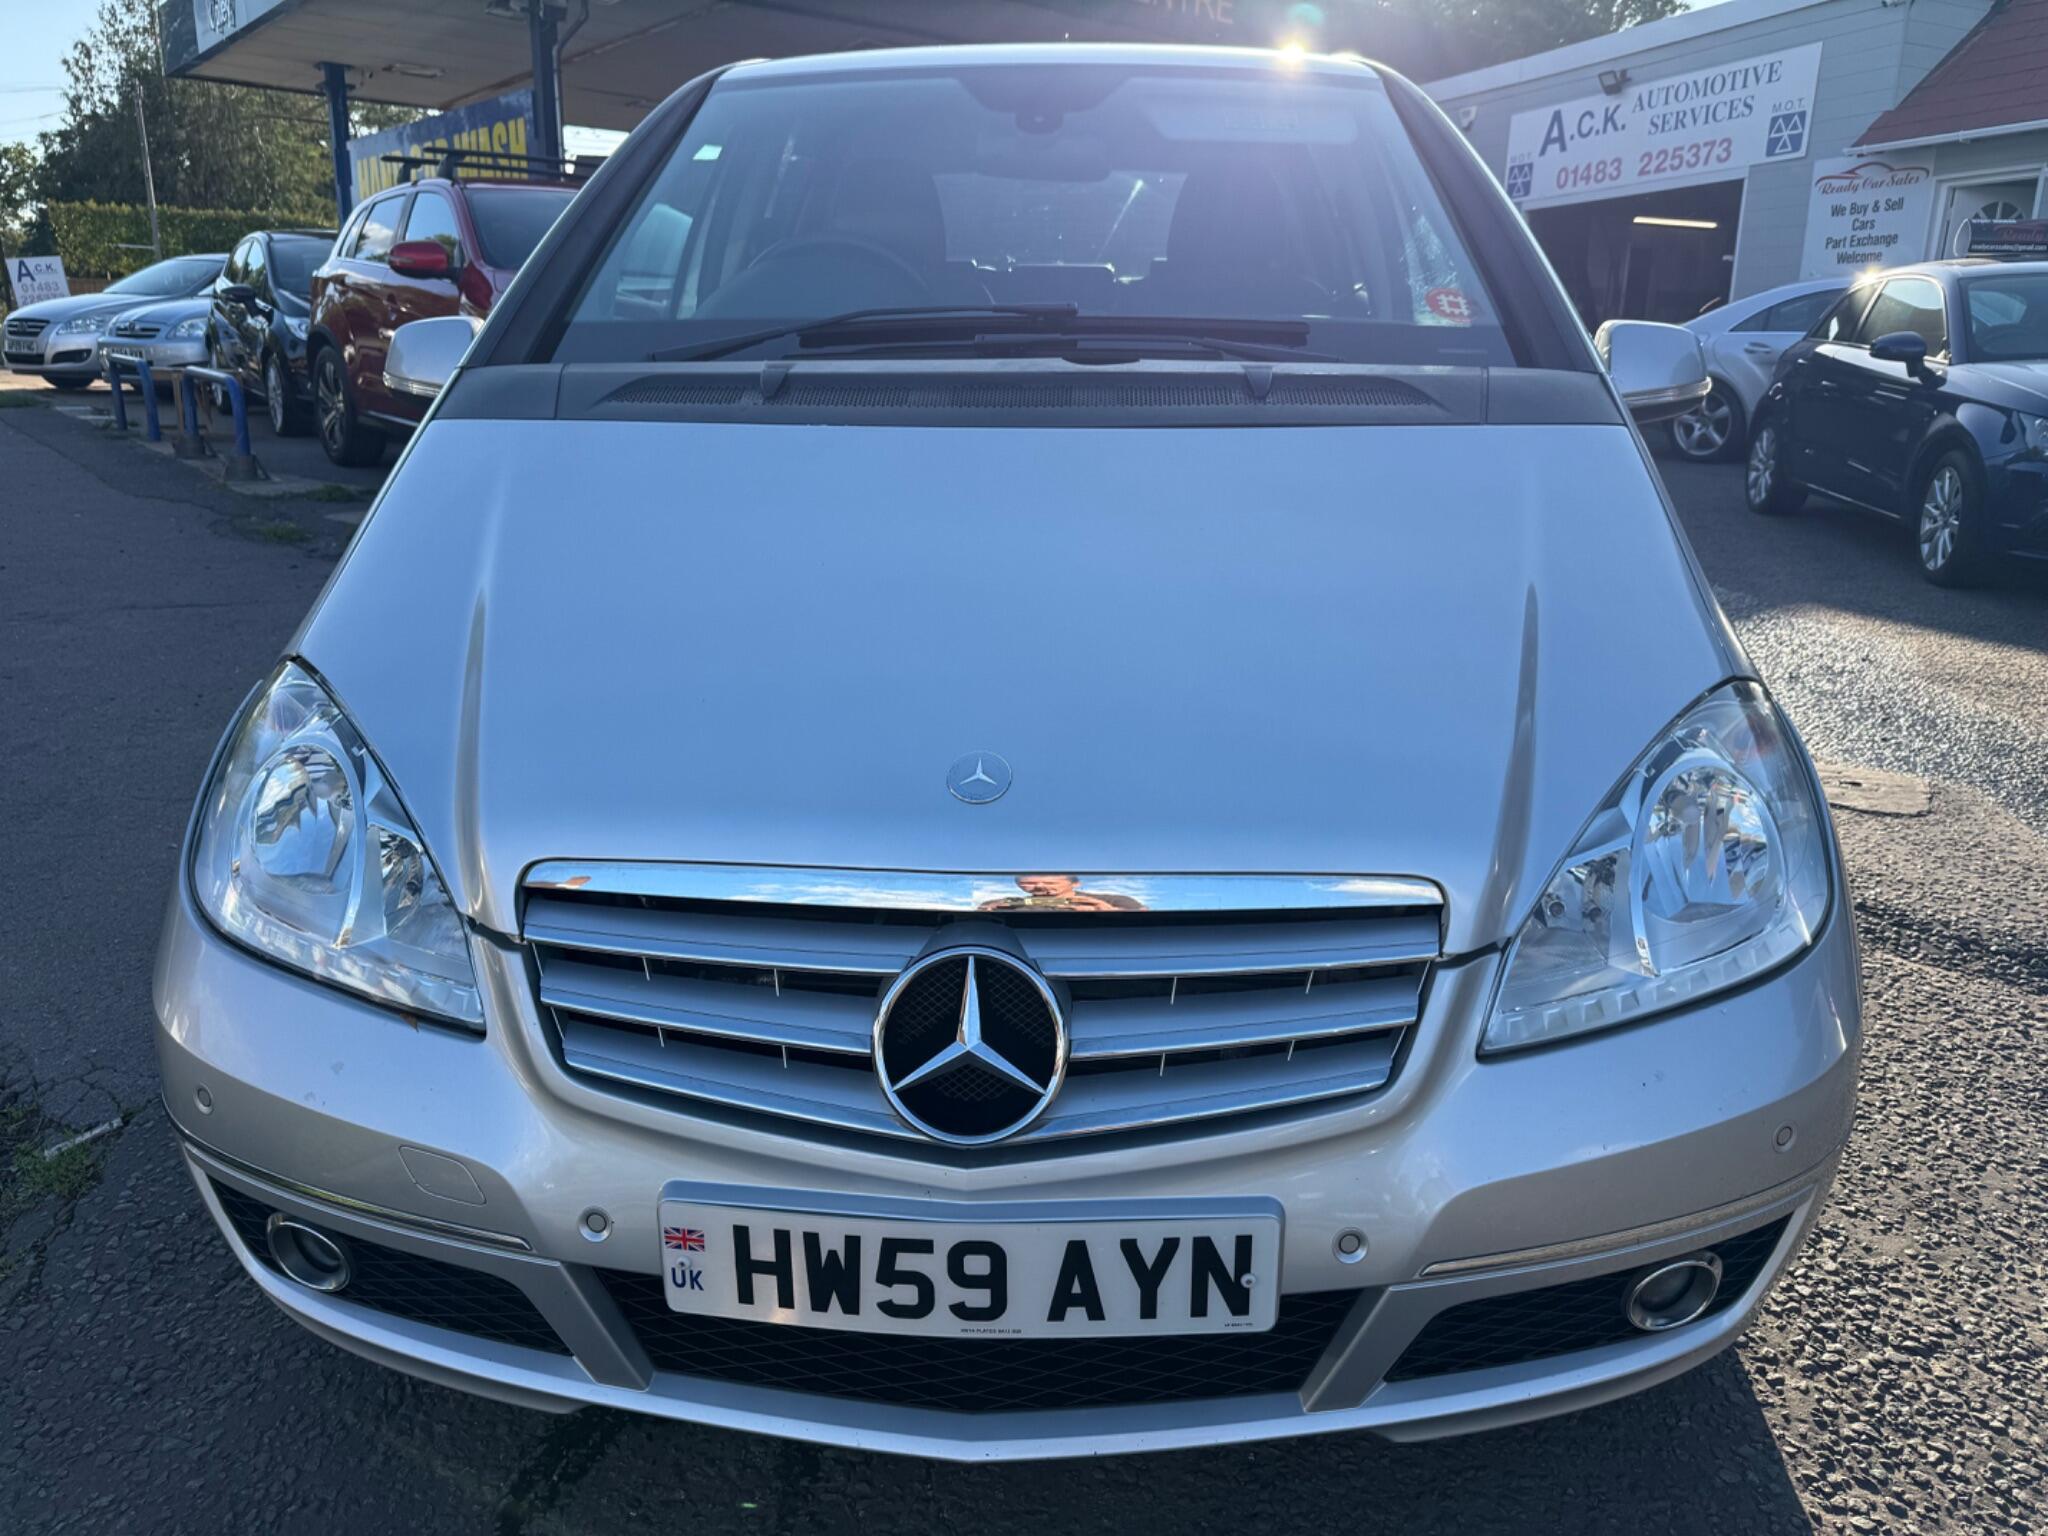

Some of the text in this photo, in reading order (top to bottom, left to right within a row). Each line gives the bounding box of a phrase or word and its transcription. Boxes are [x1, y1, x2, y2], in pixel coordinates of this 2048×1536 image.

[1632, 60, 1783, 113] AUTOMOTIVE
[1648, 96, 1755, 136] SERVICES
[1539, 104, 1627, 157] A.C.K.
[453, 117, 528, 179] WASH
[1555, 137, 1733, 190] 01483 225373
[1819, 172, 1921, 195] Ready Car Sales
[1831, 197, 1904, 217] We Buy & Sell
[1852, 218, 1876, 231] Cars
[1825, 233, 1898, 250] Part Exchange
[1837, 250, 1883, 264] Welcome
[21, 281, 60, 293] 01483
[671, 1266, 703, 1292] UK
[731, 1224, 1253, 1322] HW59 AYN
